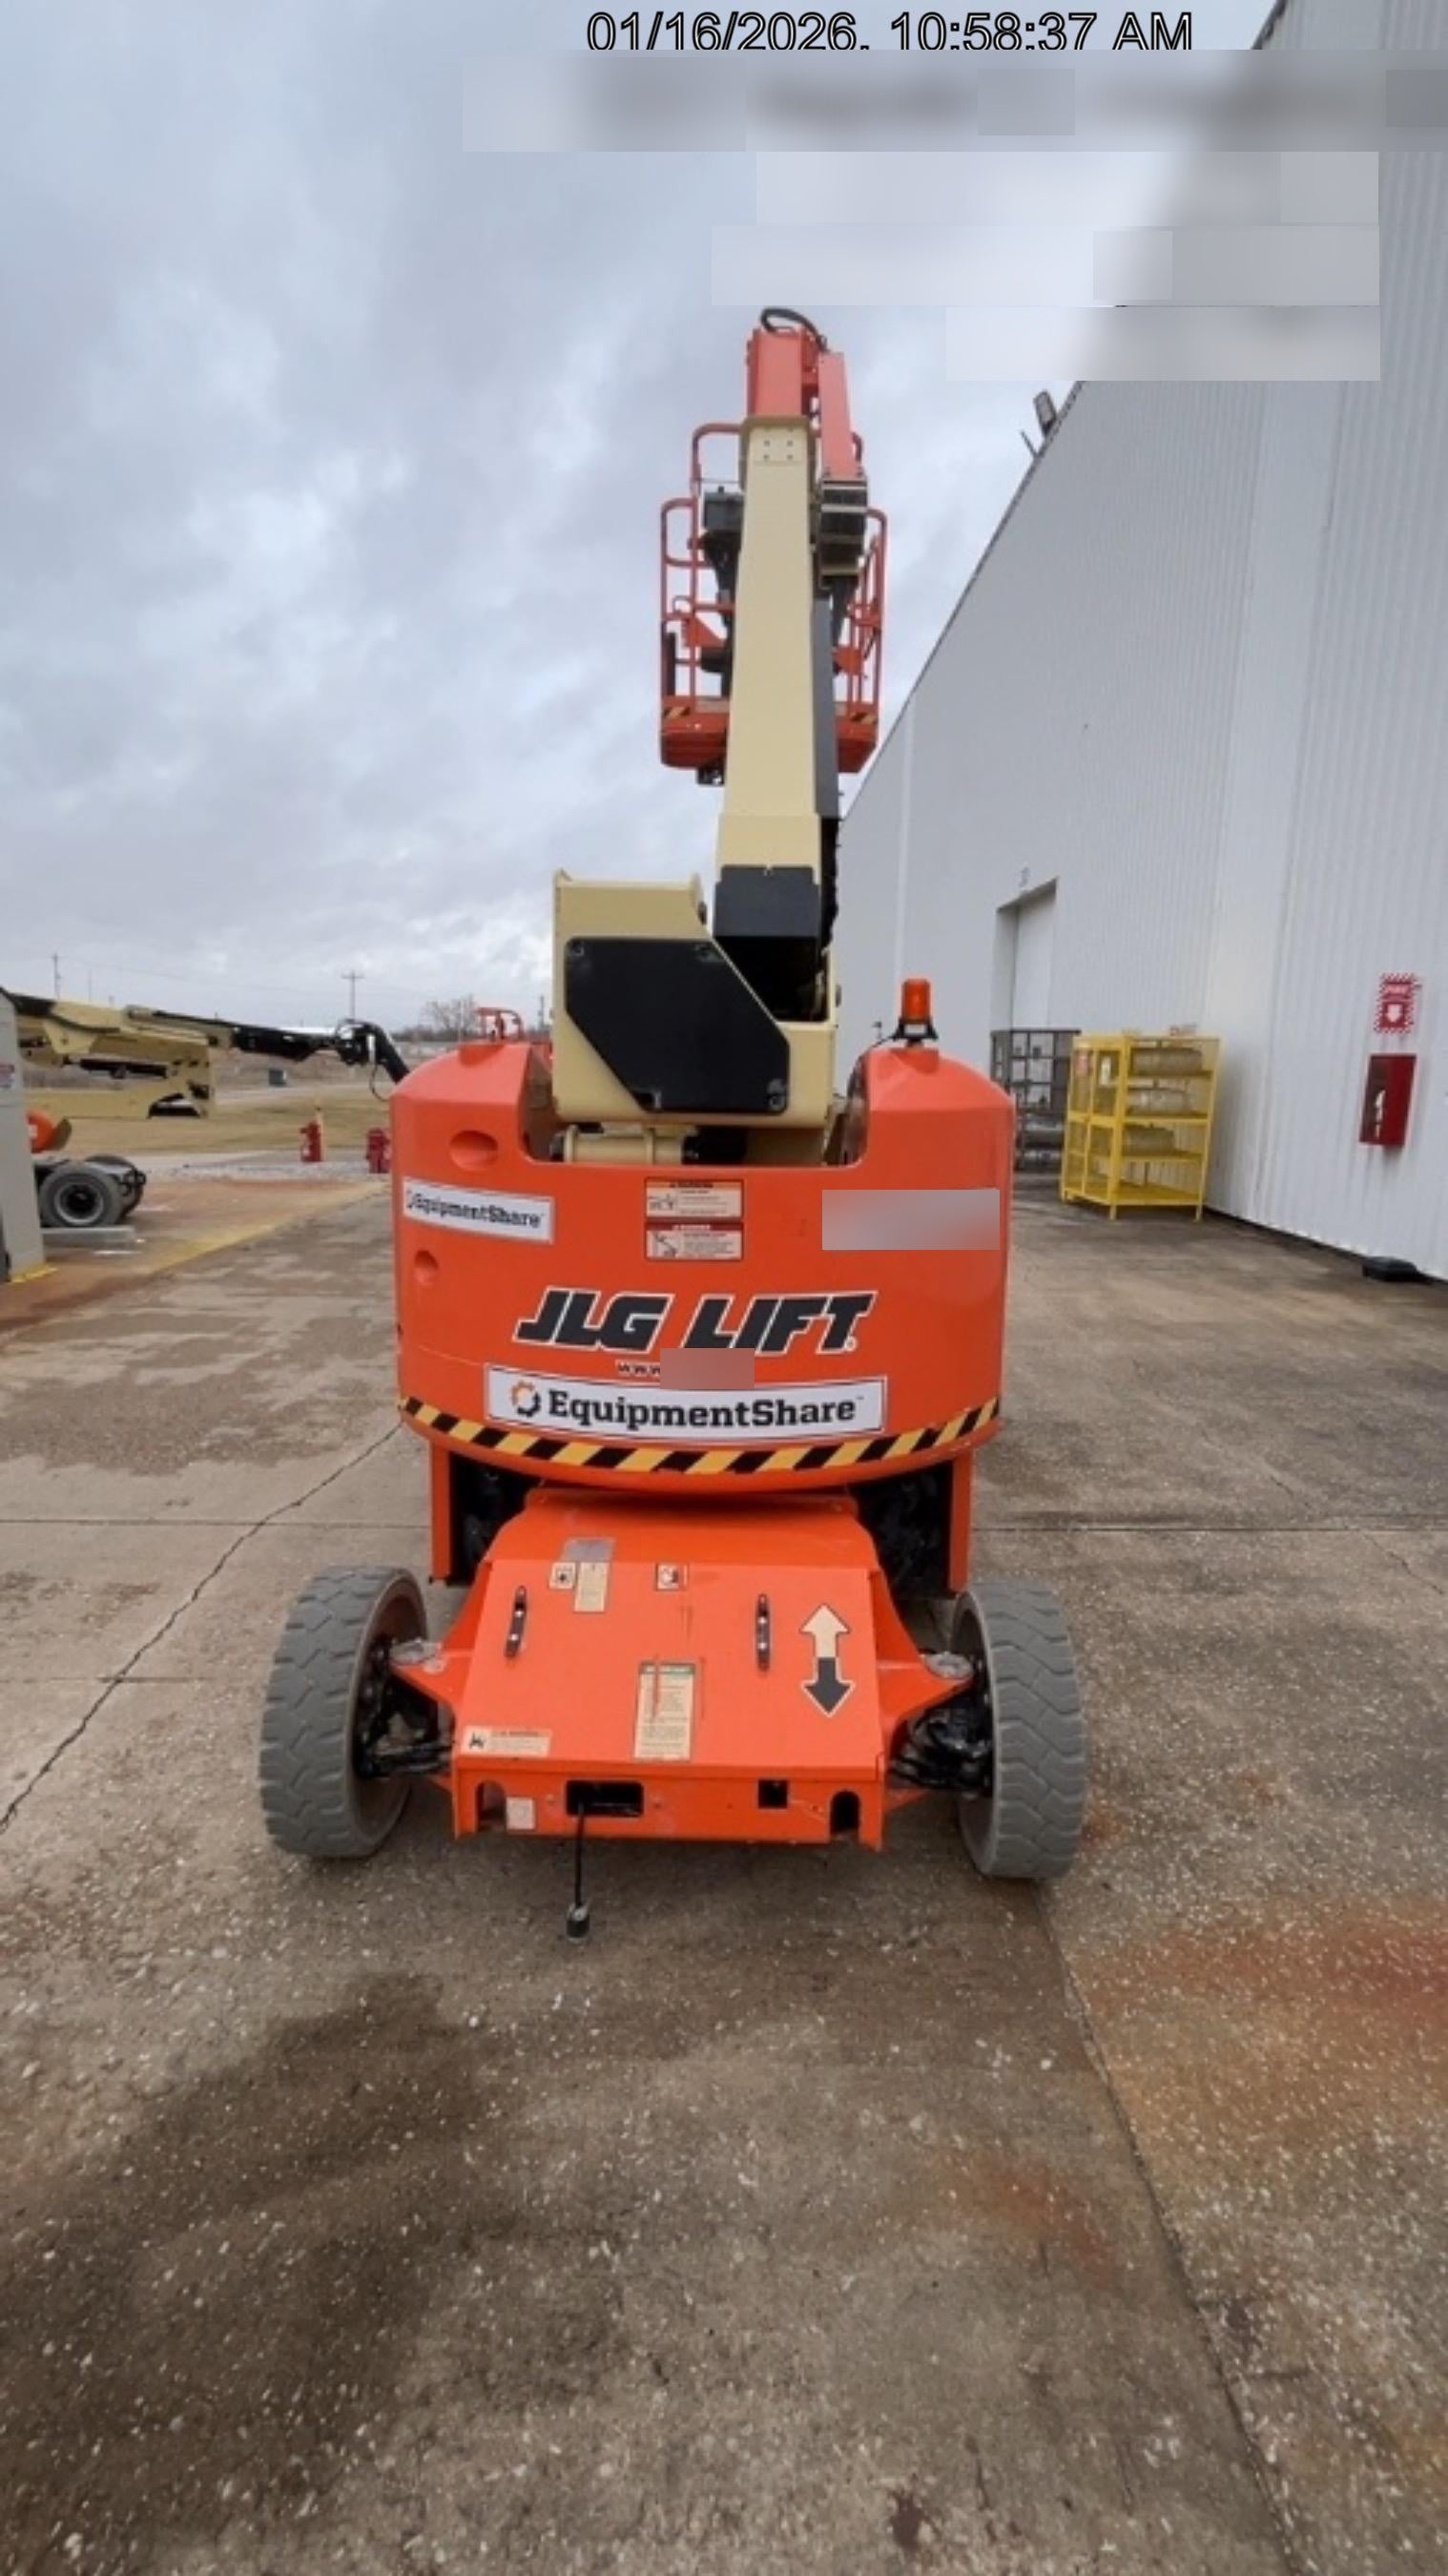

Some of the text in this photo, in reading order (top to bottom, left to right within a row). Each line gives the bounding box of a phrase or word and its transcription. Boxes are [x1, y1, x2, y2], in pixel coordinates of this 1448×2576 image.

[411, 1193, 542, 1228] EquipmentShare
[512, 1285, 878, 1354] JLG LIFT
[548, 1389, 857, 1430] EquipmentShare
